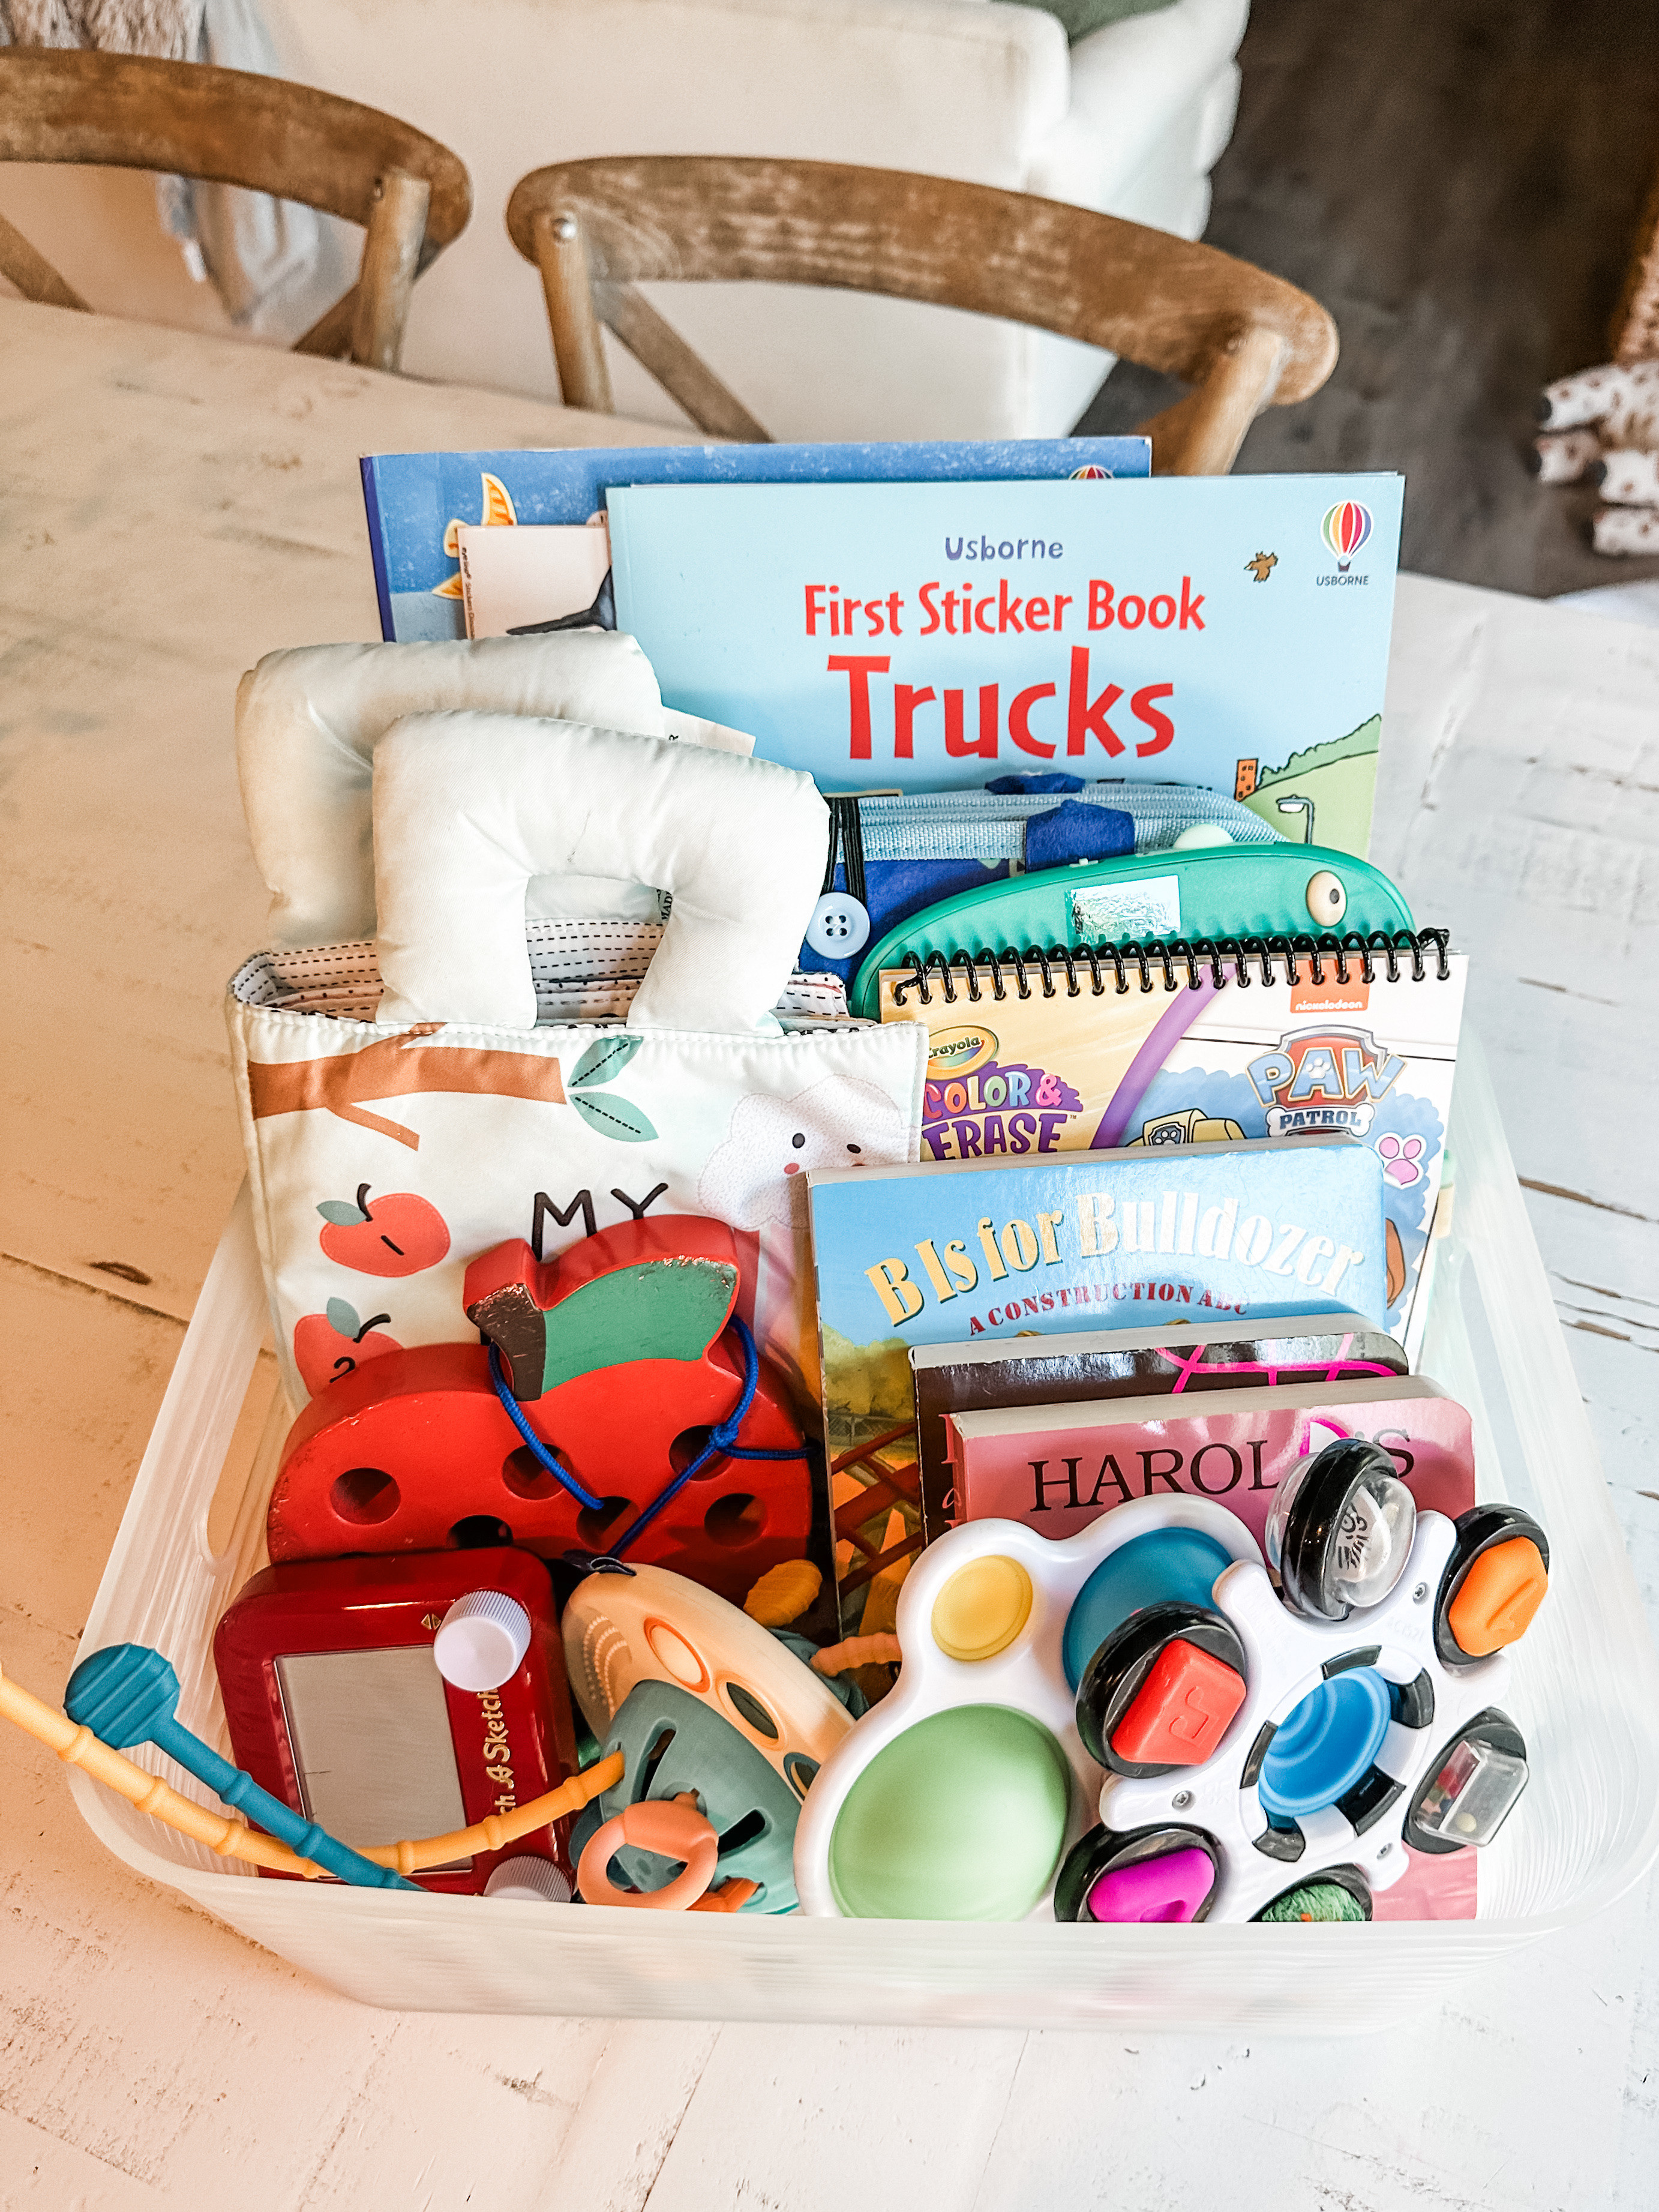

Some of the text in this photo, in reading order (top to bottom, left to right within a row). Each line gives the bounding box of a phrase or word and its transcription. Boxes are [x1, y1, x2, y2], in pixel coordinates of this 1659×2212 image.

[945, 535, 1064, 561] Usborne
[805, 576, 1206, 637] First Sticker Book
[1316, 575, 1369, 586] USBORNE
[827, 645, 1174, 760] Trucks
[1295, 999, 1363, 1011] nickelodeon
[923, 1071, 1062, 1120] COLOR &
[1246, 1047, 1408, 1108] PAW
[922, 1113, 1068, 1161] ERASE
[1279, 1110, 1362, 1129] PATROL
[532, 1182, 669, 1262] MY
[864, 1190, 1366, 1327] B Is for Bulldozer
[970, 1282, 1252, 1336] A CONSTRUCTION ABC
[477, 1688, 510, 1763] Sketch
